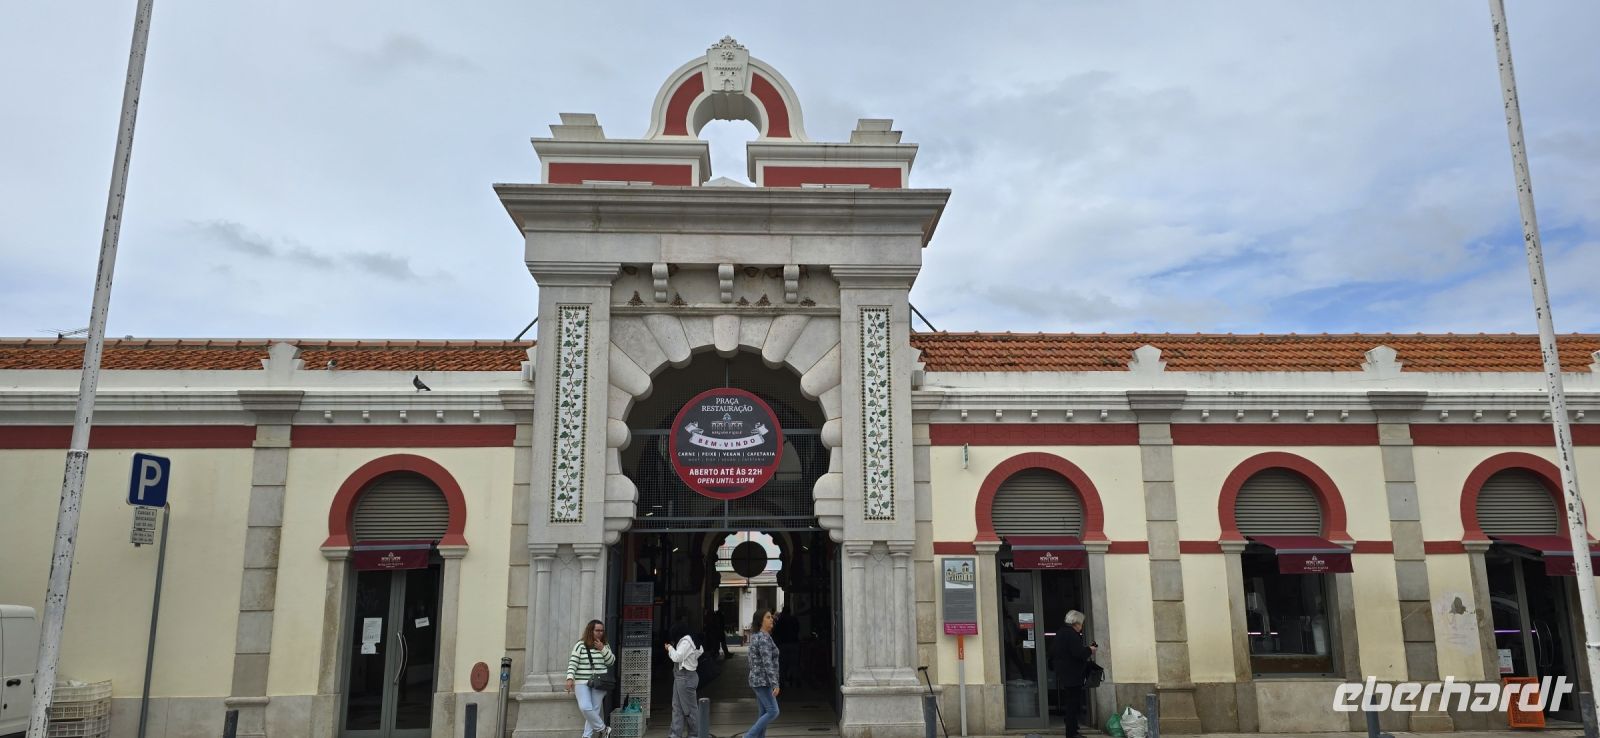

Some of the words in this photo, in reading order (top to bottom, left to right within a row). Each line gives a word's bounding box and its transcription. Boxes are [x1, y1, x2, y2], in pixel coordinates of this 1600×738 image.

[701, 404, 753, 413] RESTAURAÇÃO
[698, 438, 756, 448] BEM-VINDO
[689, 468, 719, 476] ABERTO
[720, 467, 734, 475] ATÉ
[747, 468, 763, 476] 22H
[137, 458, 162, 500] P
